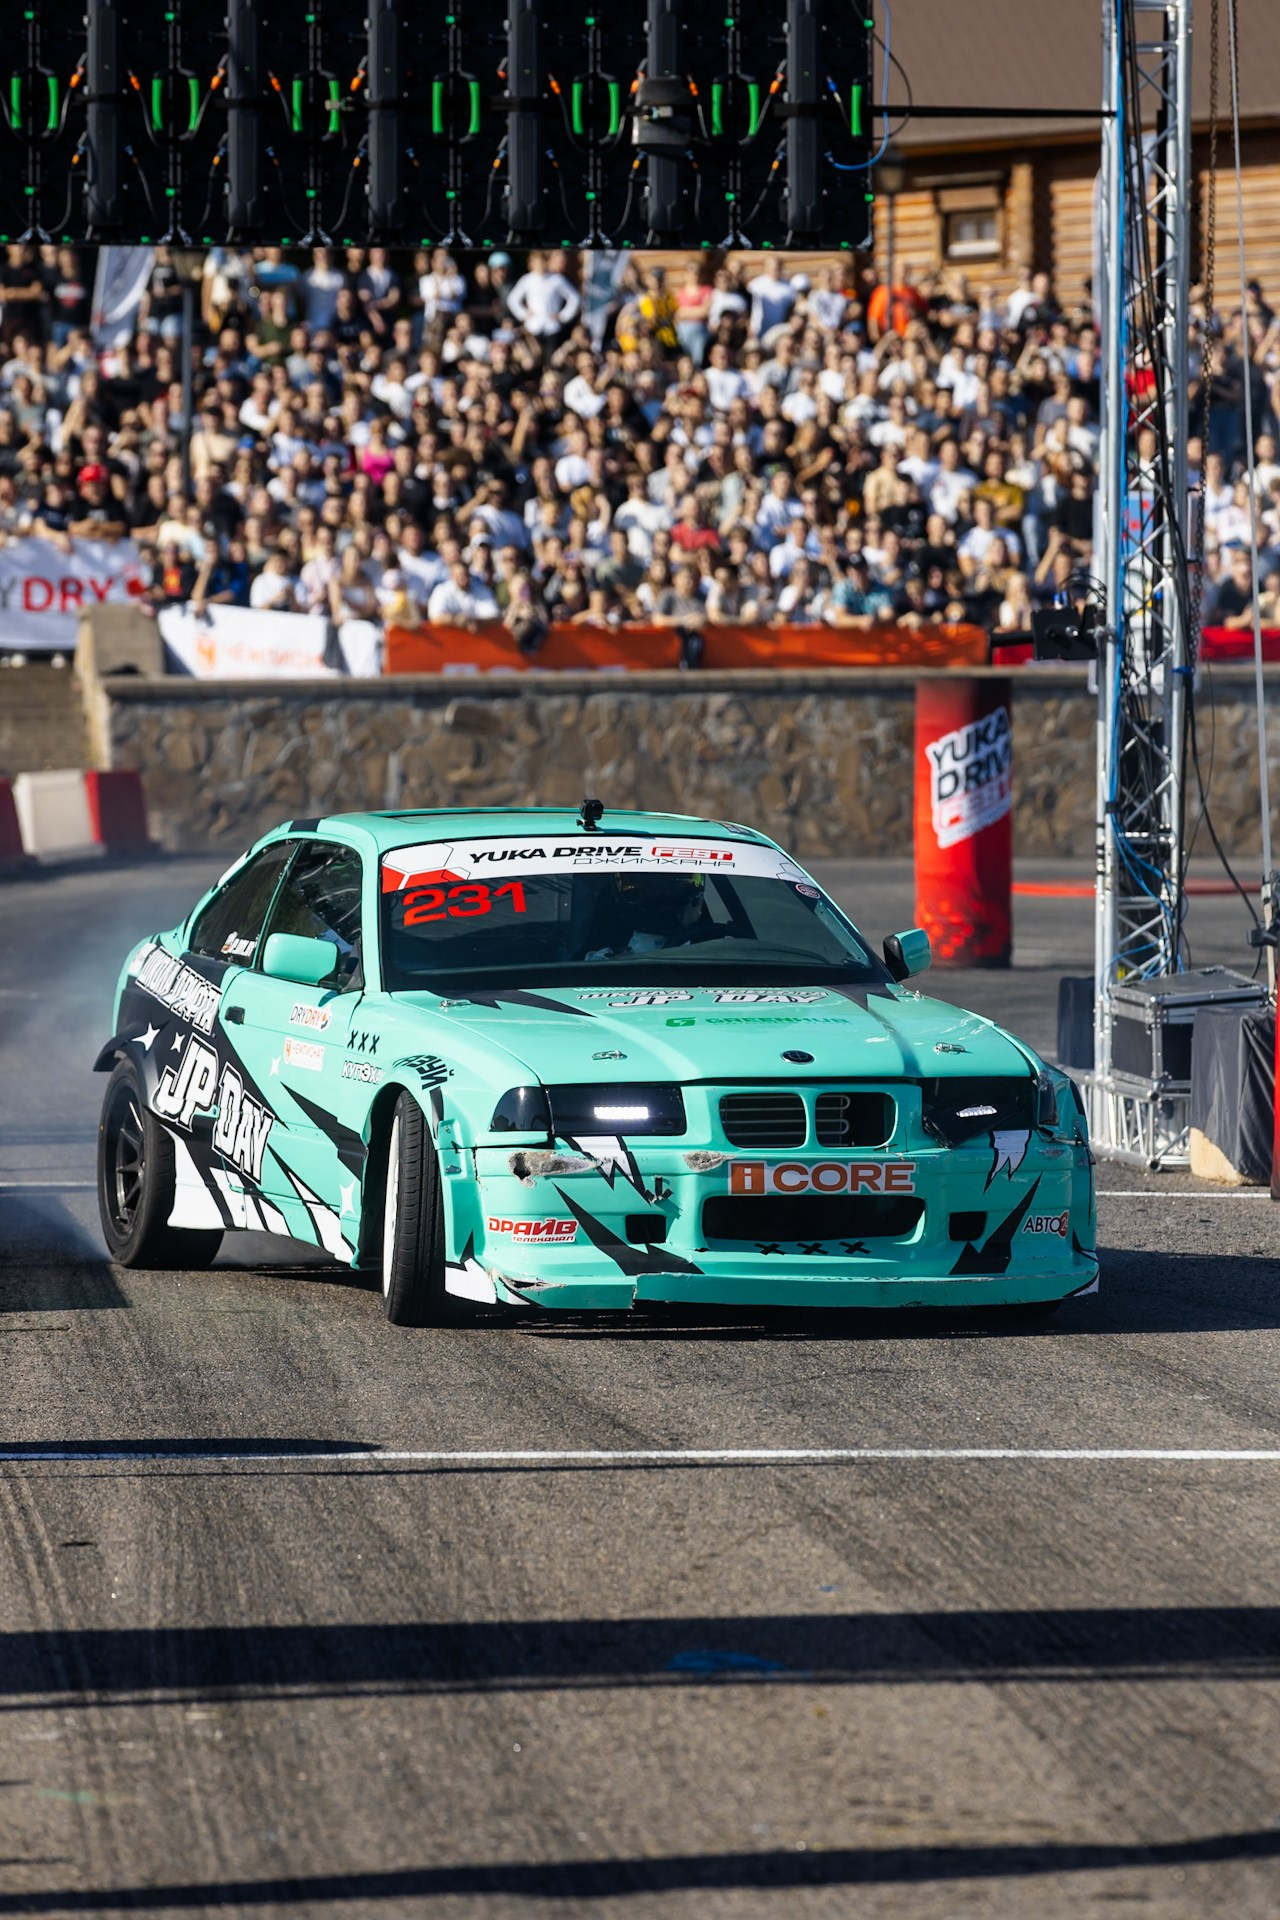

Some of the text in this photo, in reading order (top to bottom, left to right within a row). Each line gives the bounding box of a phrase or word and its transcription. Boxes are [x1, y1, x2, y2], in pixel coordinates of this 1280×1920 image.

[938, 742, 1013, 802] DRIV
[469, 846, 733, 864] YUKA DRIVE FEST
[402, 882, 527, 926] 231
[607, 994, 825, 1007] JP DAY
[151, 1033, 275, 1185] JP DAY
[773, 1164, 914, 1192] CORE
[489, 1218, 577, 1235] ДРАЙВ
[1023, 1215, 1068, 1233] АВТО2
